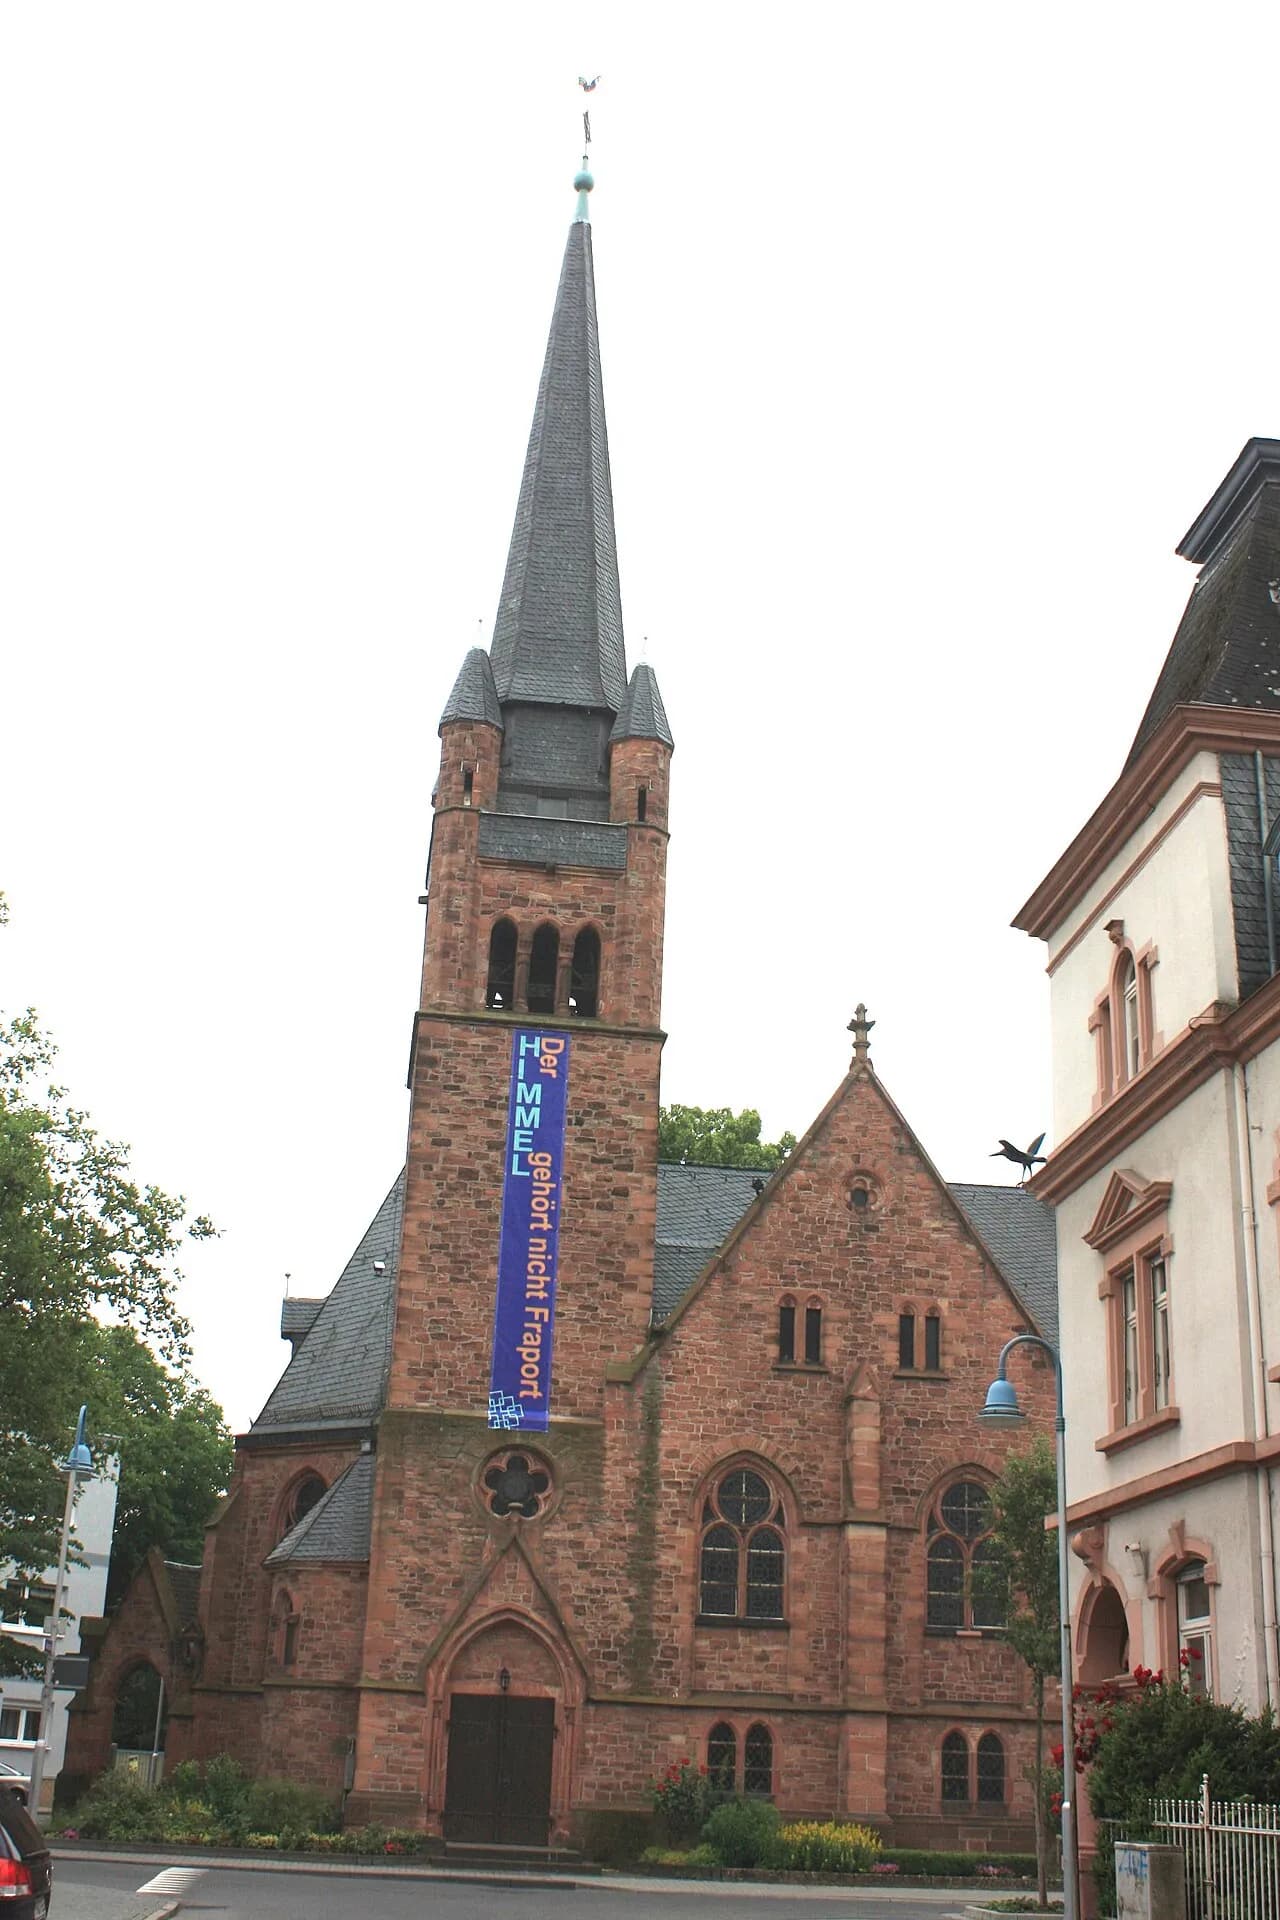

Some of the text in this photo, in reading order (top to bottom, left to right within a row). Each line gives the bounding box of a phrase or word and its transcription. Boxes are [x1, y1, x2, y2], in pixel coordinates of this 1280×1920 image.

[511, 1035, 542, 1176] HIMMEL
[516, 1037, 565, 1400] Der gehört nicht Fraport
